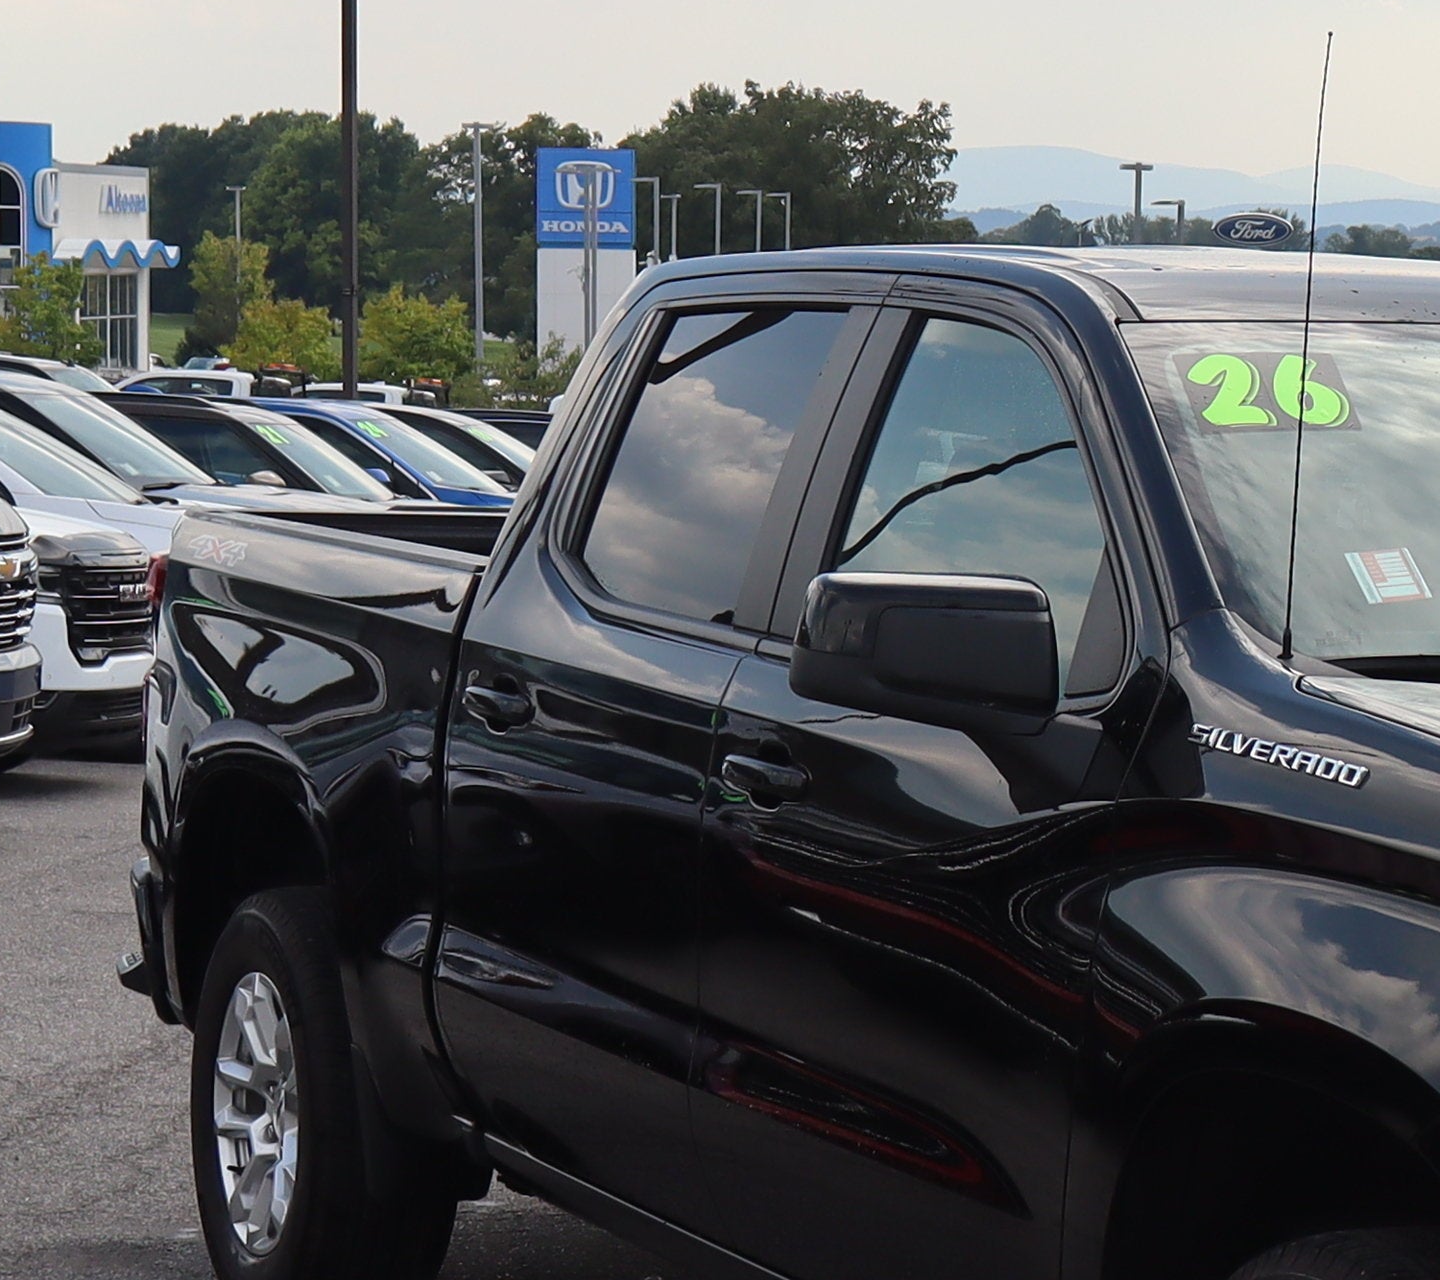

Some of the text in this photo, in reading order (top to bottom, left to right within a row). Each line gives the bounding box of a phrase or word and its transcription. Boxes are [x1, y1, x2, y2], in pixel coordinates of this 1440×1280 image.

[1230, 220, 1276, 239] Ford
[1186, 353, 1352, 428] 26
[1187, 722, 1370, 788] SILVERADO
